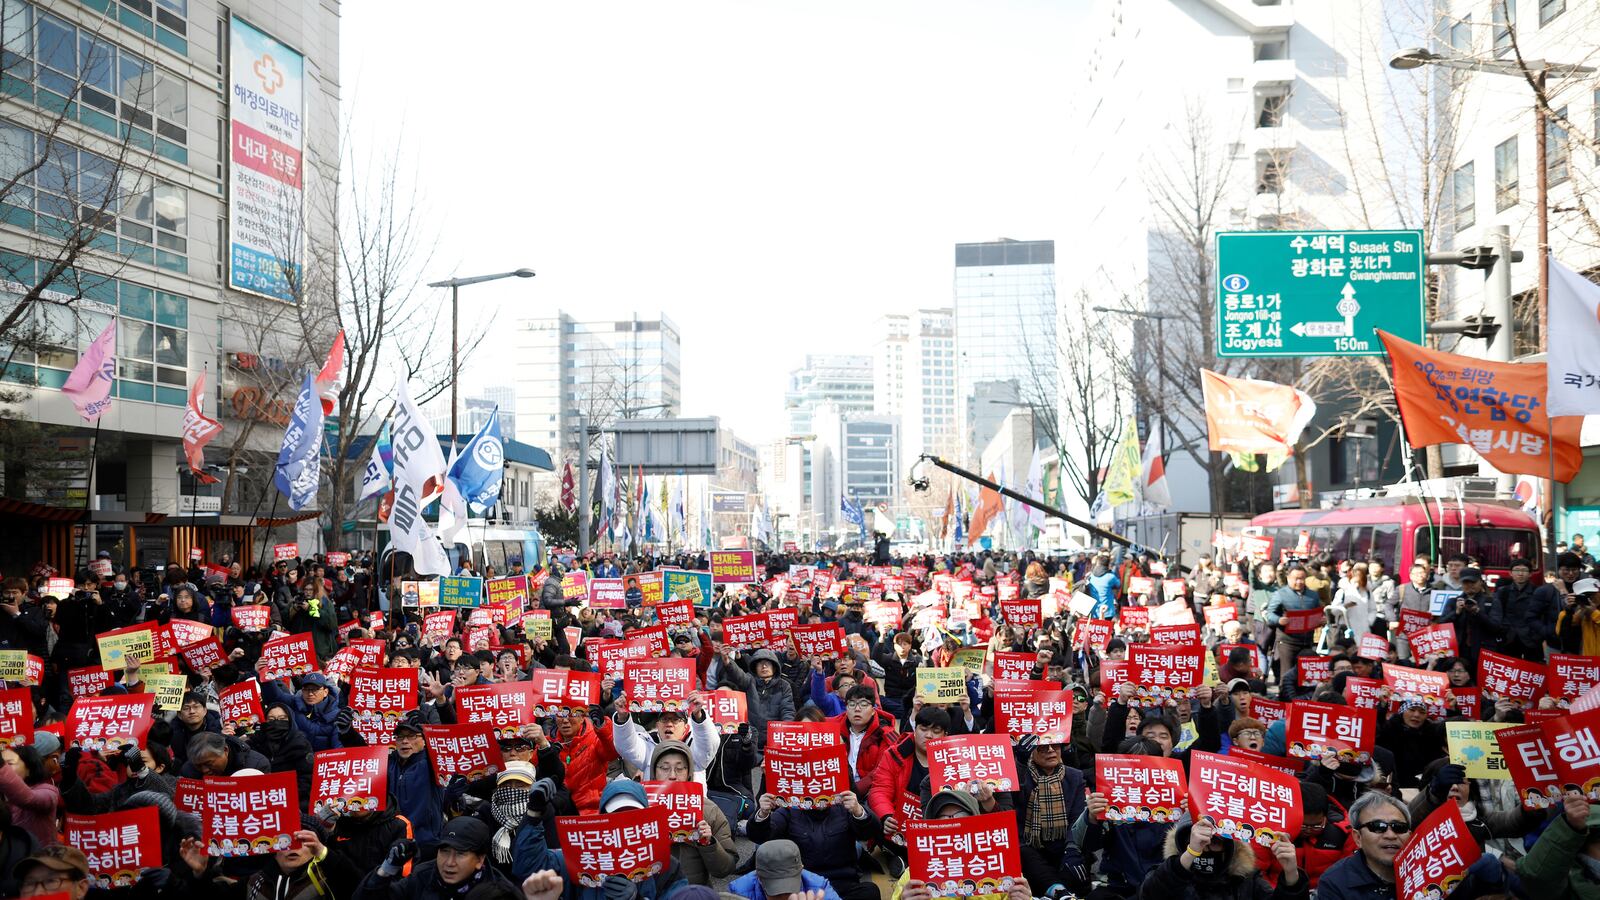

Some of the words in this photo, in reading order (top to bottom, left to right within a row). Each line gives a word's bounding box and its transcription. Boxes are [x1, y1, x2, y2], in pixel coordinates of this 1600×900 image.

[239, 133, 268, 164] 내과
[271, 149, 297, 177] 전문
[1290, 235, 1344, 254] 수색역
[1349, 242, 1389, 253] Susaek
[1394, 241, 1413, 252] Stn
[1291, 258, 1346, 277] 광화문
[1350, 256, 1391, 269] 光化門
[1230, 278, 1241, 290] 6
[1350, 270, 1415, 283] Gwanghwamun
[1224, 293, 1282, 310] 종로1가
[1224, 310, 1254, 322] Jongno
[1225, 322, 1282, 339] 조계사
[1225, 336, 1282, 350] Jogyesa
[1334, 338, 1368, 350] 150m
[1460, 367, 1495, 385] 희망
[712, 554, 742, 564] 헌재는
[711, 566, 753, 578] 탄핵하라
[649, 631, 663, 643] 탄핵
[1412, 632, 1433, 647] 박근혜
[1431, 630, 1451, 641] 탄핵
[184, 646, 202, 658] 박근혜
[202, 642, 218, 654] 탄핵
[264, 644, 290, 659] 박근혜
[290, 640, 308, 655] 탄핵
[602, 648, 628, 660] 박근혜
[629, 646, 646, 657] 탄핵
[815, 641, 833, 652] 승리
[1418, 643, 1430, 655] 촛불
[1429, 638, 1448, 650] 승리
[204, 650, 219, 663] 승리
[268, 657, 285, 669] 촛불
[287, 652, 306, 665] 승리
[998, 659, 1024, 670] 박근혜
[1135, 654, 1172, 669] 박근혜
[1175, 656, 1198, 669] 탄핵
[71, 674, 90, 685] 박근혜
[90, 672, 108, 685] 탄핵
[629, 668, 664, 682] 박근혜
[666, 668, 688, 682] 탄핵
[1106, 671, 1128, 680] 박근
[1140, 669, 1166, 684] 촛불
[1168, 671, 1192, 684] 승리
[1388, 668, 1419, 684] 박근혜
[1419, 675, 1444, 687] 탄핵
[1483, 658, 1519, 682] 박근혜
[1520, 671, 1544, 687] 탄핵
[1557, 665, 1599, 681] 박근혜
[88, 682, 106, 693] 승리
[355, 678, 383, 693] 박근혜
[386, 679, 410, 692] 탄핵
[542, 677, 589, 705] 탄핵
[634, 684, 657, 698] 촛불
[660, 684, 684, 698] 승리
[1350, 683, 1382, 698] 박근혜
[1394, 680, 1417, 691] 촛불
[1417, 681, 1441, 695] 승리
[1484, 675, 1508, 693] 촛불
[1509, 683, 1534, 698] 승리
[1563, 681, 1594, 697] 촛불
[235, 689, 252, 701] 탄핵
[355, 693, 377, 708] 촛불
[379, 694, 404, 708] 승리
[462, 695, 499, 711] 박근혜
[500, 692, 526, 708] 탄핵
[76, 705, 117, 720] 박근혜
[117, 704, 144, 718] 탄핵
[232, 703, 251, 717] 승리
[1001, 702, 1040, 716] 박근혜
[1042, 699, 1066, 716] 탄핵
[1255, 706, 1284, 719] 박근혜
[352, 718, 382, 730] 박근혜
[495, 709, 521, 725] 승리
[1008, 718, 1033, 732] 촛불
[1035, 715, 1062, 734] 승리
[0, 719, 16, 733] 리
[76, 721, 104, 737] 촛불
[106, 720, 134, 735] 승리
[1302, 712, 1362, 748] 탄핵
[774, 732, 809, 746] 박근혜
[811, 733, 834, 746] 탄핵
[1450, 730, 1482, 740] 박근혜
[429, 738, 459, 754] 박근혜
[459, 734, 489, 751] 탄핵
[437, 755, 456, 772] 촛불
[455, 750, 488, 770] 승리
[934, 746, 976, 764] 박근혜
[978, 745, 1005, 760] 탄핵
[1517, 728, 1600, 781] 탄핵
[318, 760, 350, 778] 박근혜
[352, 758, 380, 775] 탄핵
[771, 760, 810, 777] 박근혜
[813, 758, 840, 776] 탄핵
[943, 762, 971, 781] 촛불
[974, 762, 1002, 777] 승리
[777, 778, 805, 794] 촛불
[807, 776, 836, 794] 승리
[1104, 767, 1149, 784] 박근혜
[1151, 769, 1180, 786] 탄핵
[320, 779, 341, 796] 촛불
[343, 776, 373, 795] 승리
[1200, 767, 1257, 798] 박근혜
[1259, 780, 1293, 808] 탄핵
[208, 792, 247, 812] 박근혜
[250, 788, 287, 810] 탄핵
[676, 794, 701, 810] 탄핵
[1111, 786, 1142, 803] 촛불
[1145, 787, 1174, 804] 승리
[1206, 792, 1246, 818] 촛불
[1249, 802, 1285, 828] 승리
[212, 814, 239, 835] 촛불
[242, 811, 280, 834] 승리
[668, 812, 696, 828] 승리
[70, 825, 140, 851] 박근혜를
[568, 828, 622, 850] 박근혜
[623, 821, 657, 847] 탄핵
[917, 833, 972, 856] 박근혜
[975, 828, 1009, 852] 탄핵
[1398, 841, 1426, 879] 박근혜
[1426, 817, 1458, 852] 탄핵
[86, 845, 142, 871] 속하라
[580, 852, 615, 870] 촛불
[618, 844, 654, 868] 승리
[927, 857, 964, 878] 촛불
[968, 852, 1004, 876] 승리
[1404, 866, 1424, 899] 촛불
[1426, 844, 1464, 878] 승리
